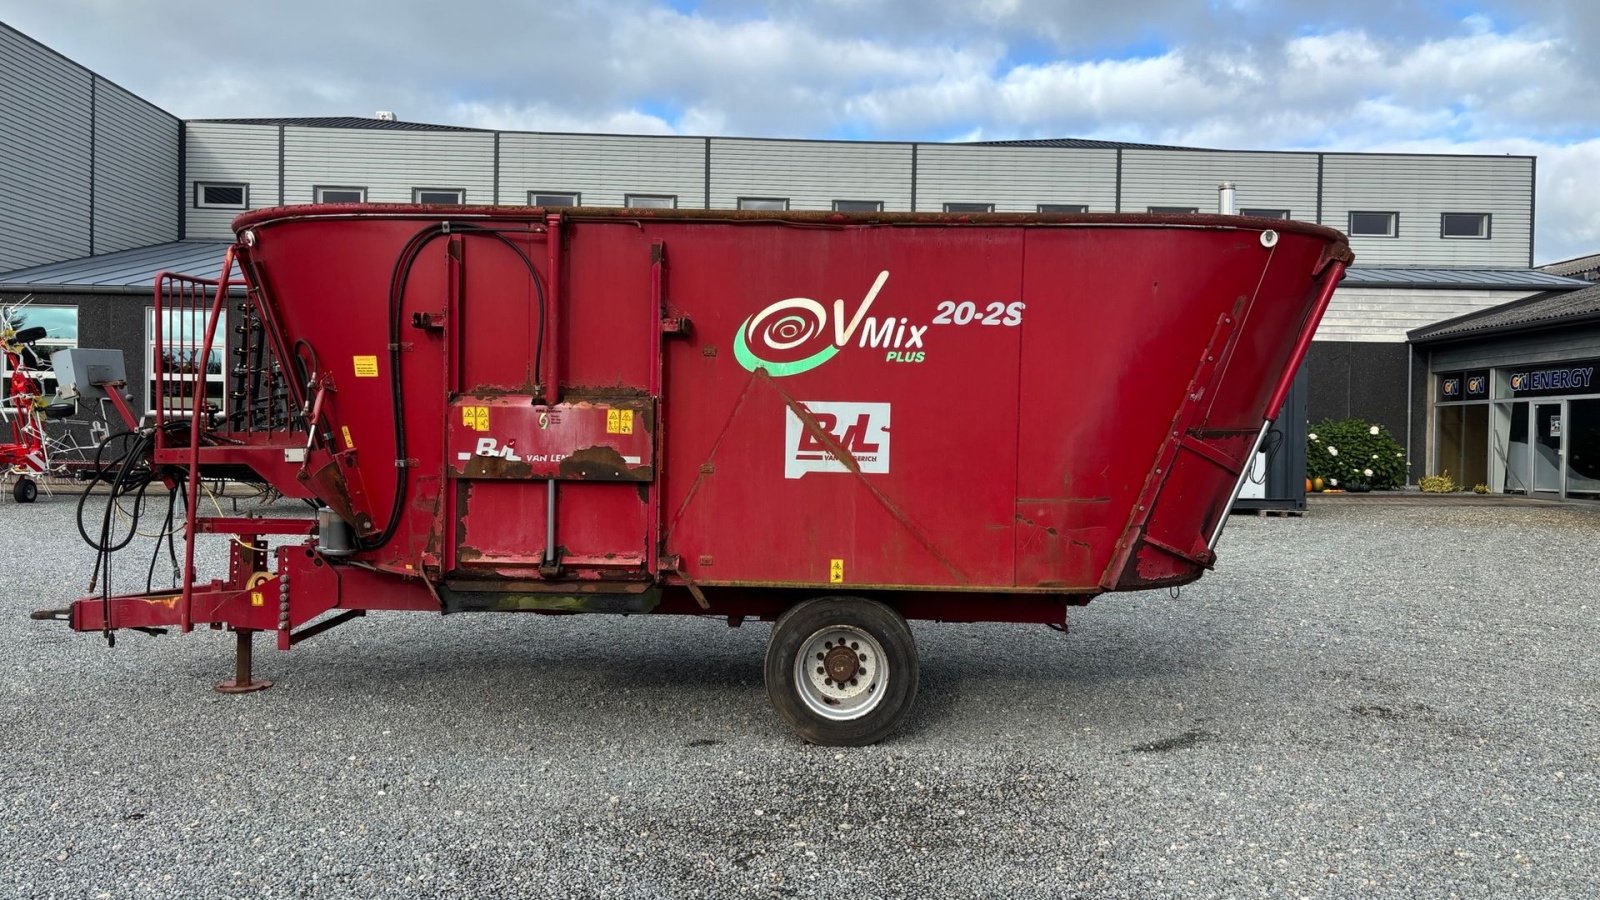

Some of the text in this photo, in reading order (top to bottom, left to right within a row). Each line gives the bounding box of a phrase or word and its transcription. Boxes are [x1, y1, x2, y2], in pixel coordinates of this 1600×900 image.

[932, 301, 1026, 326] 20-2S
[886, 351, 925, 363] PLUS
[1530, 367, 1593, 390] ENERGY
[526, 454, 548, 462] VAN
